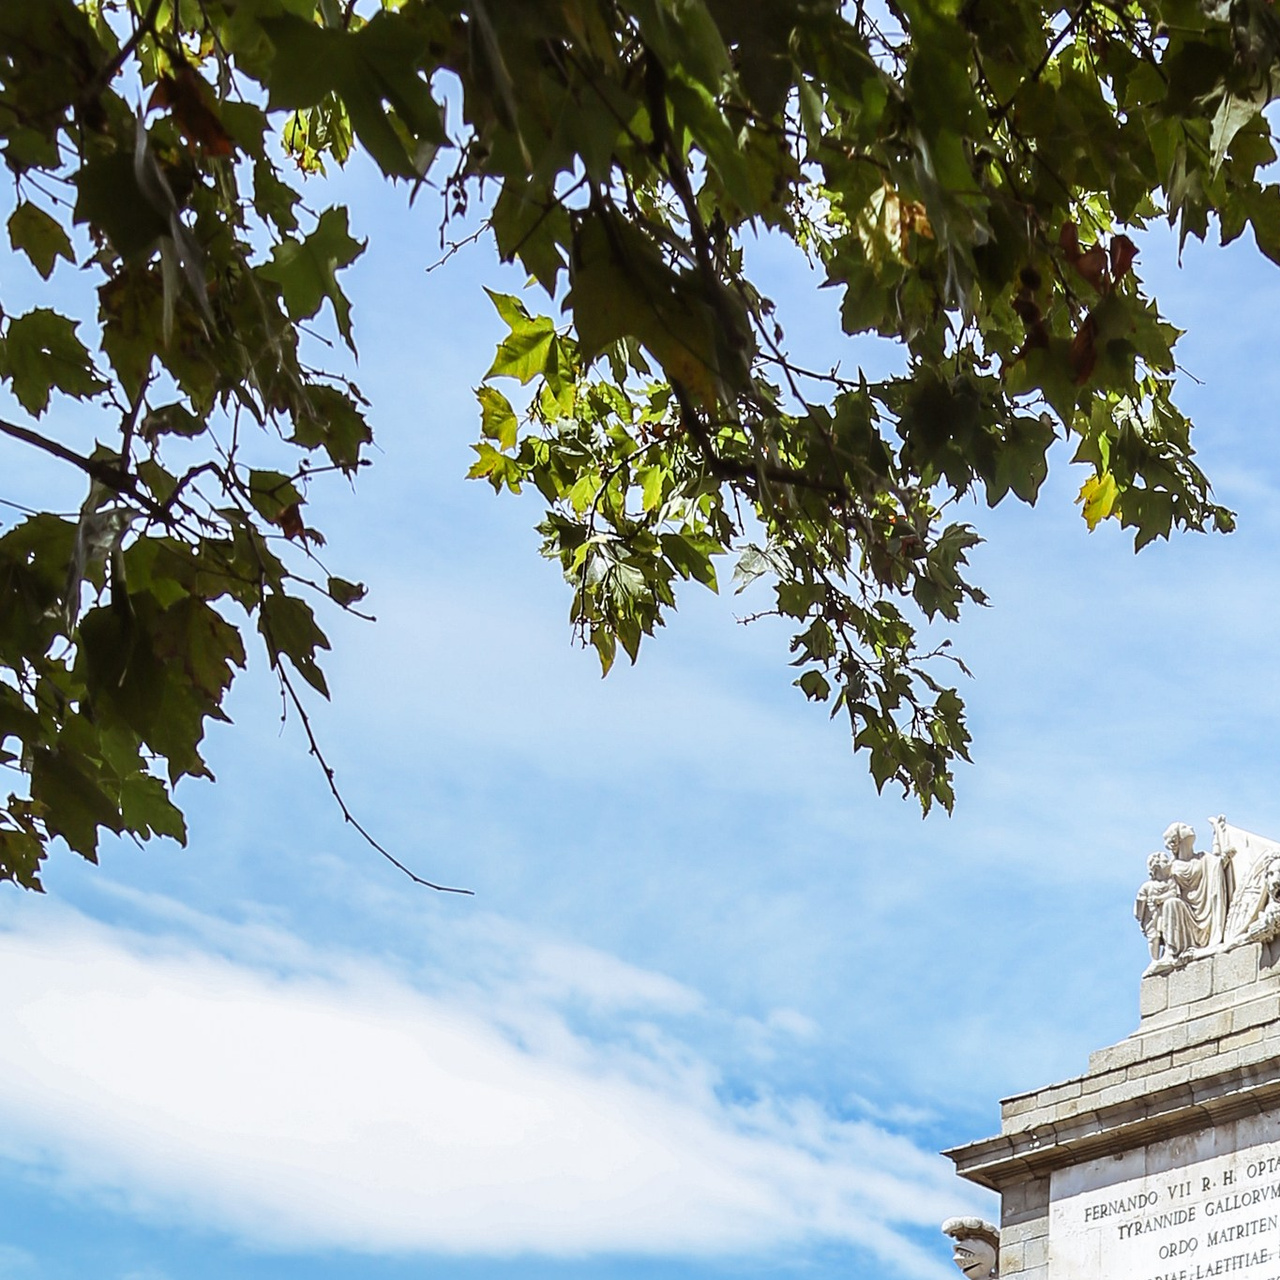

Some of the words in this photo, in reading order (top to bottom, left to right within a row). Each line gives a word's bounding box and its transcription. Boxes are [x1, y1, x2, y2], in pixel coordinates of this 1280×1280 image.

[1084, 1190, 1159, 1223] FERNANDO
[1167, 1180, 1192, 1200] VII
[1201, 1176, 1217, 1192] R.
[1222, 1169, 1238, 1186] H.
[1117, 1206, 1196, 1240] TYRANNIDE
[1158, 1237, 1199, 1260] ORDO
